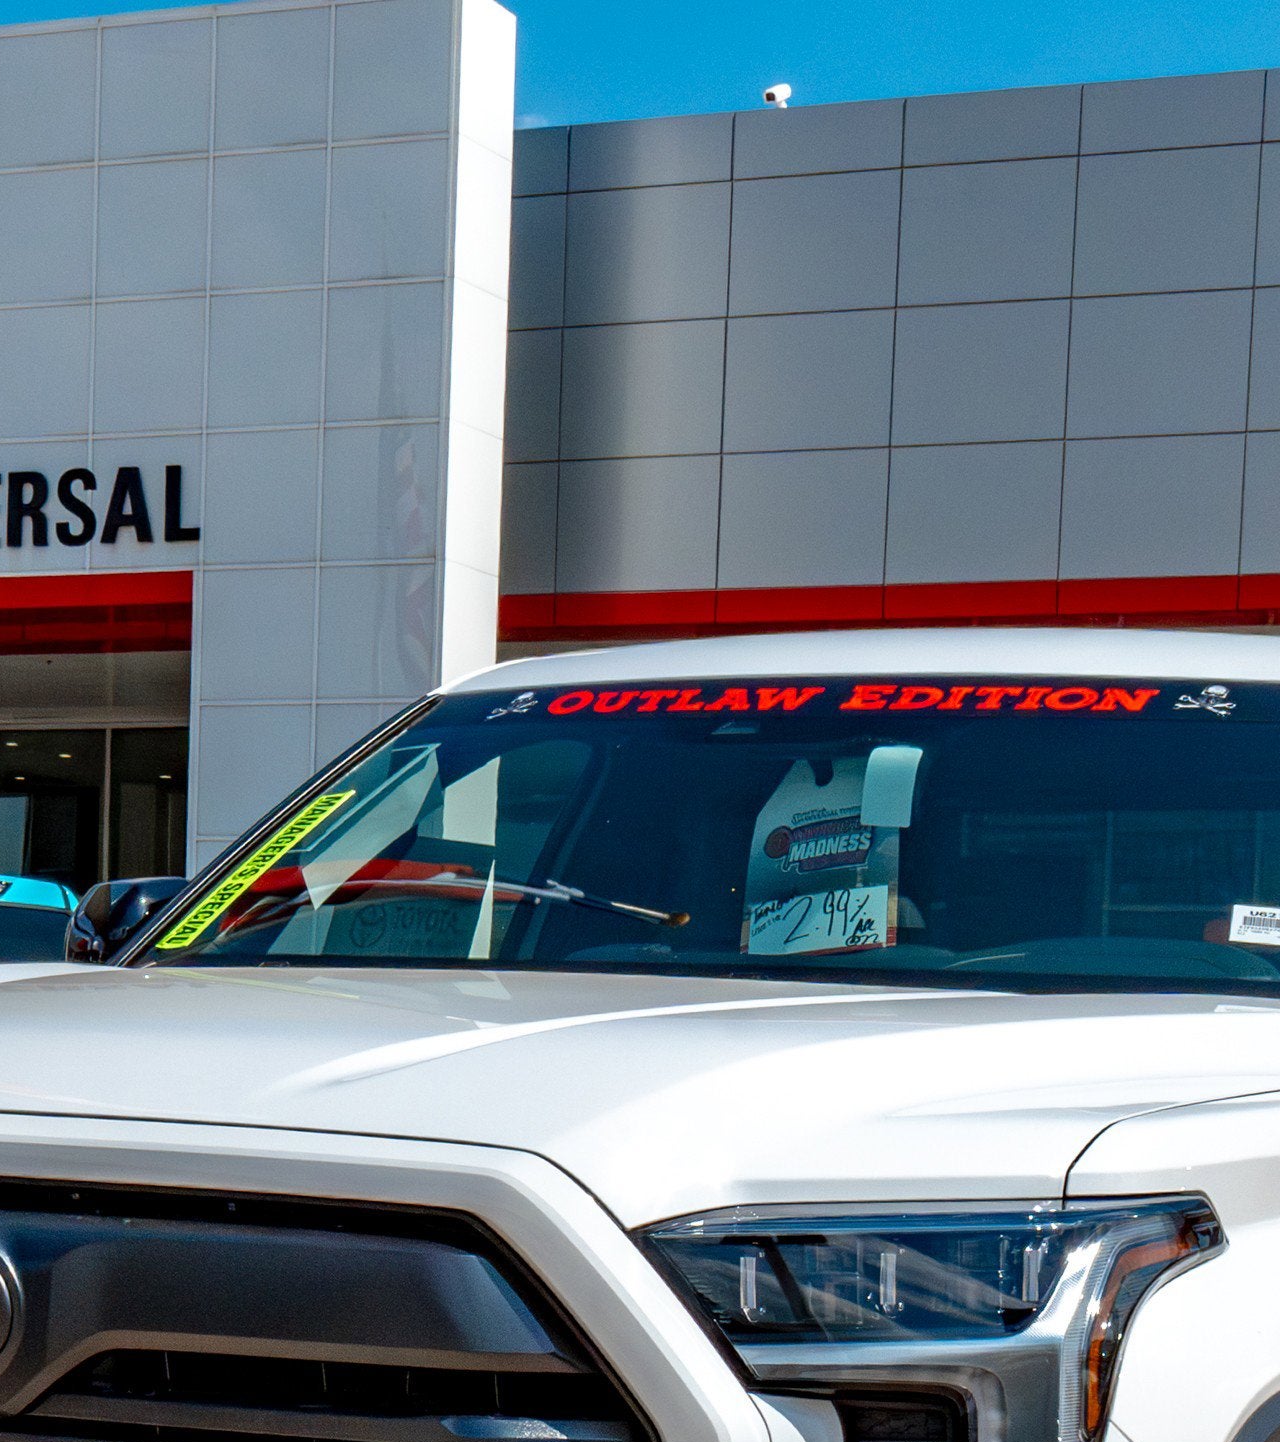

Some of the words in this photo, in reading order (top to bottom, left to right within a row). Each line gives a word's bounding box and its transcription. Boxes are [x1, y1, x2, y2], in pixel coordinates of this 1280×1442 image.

[547, 686, 826, 715] OUTLAW
[838, 684, 1160, 712] EDITION
[237, 795, 342, 880] MANAGER'S
[789, 833, 872, 862] MADNESS
[166, 882, 243, 945] SPECIAL
